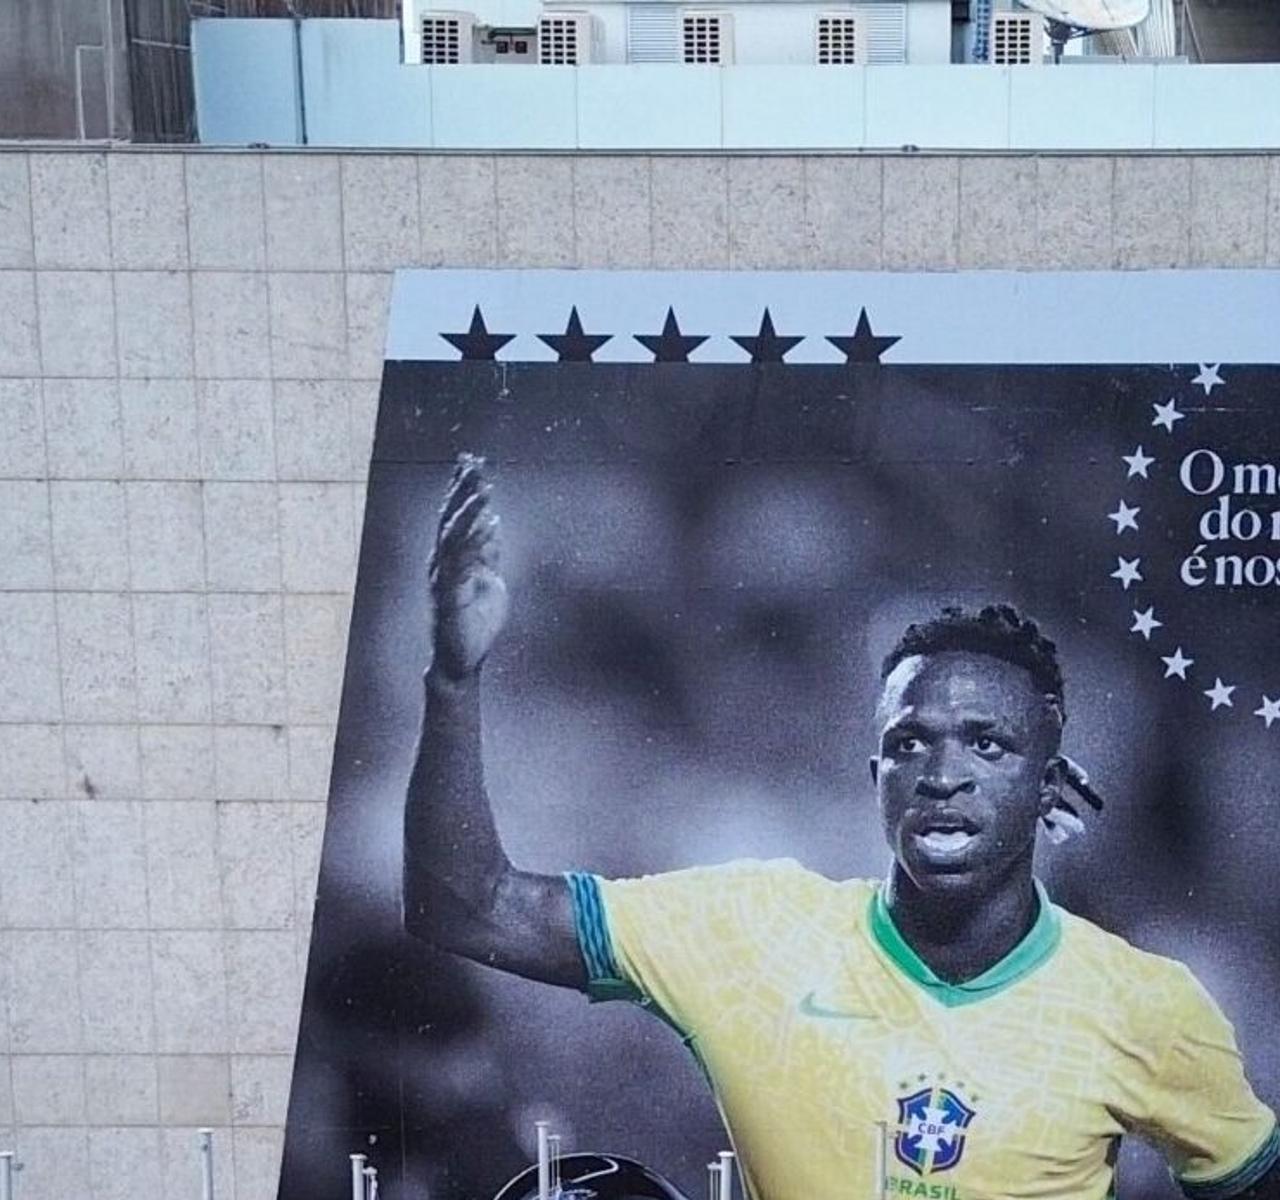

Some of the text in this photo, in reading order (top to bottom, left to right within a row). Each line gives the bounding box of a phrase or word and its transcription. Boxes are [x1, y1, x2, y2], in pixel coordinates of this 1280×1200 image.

[1179, 448, 1225, 495] O
[1199, 494, 1262, 541] do
[1180, 544, 1207, 587] é
[918, 1122, 945, 1136] CBF
